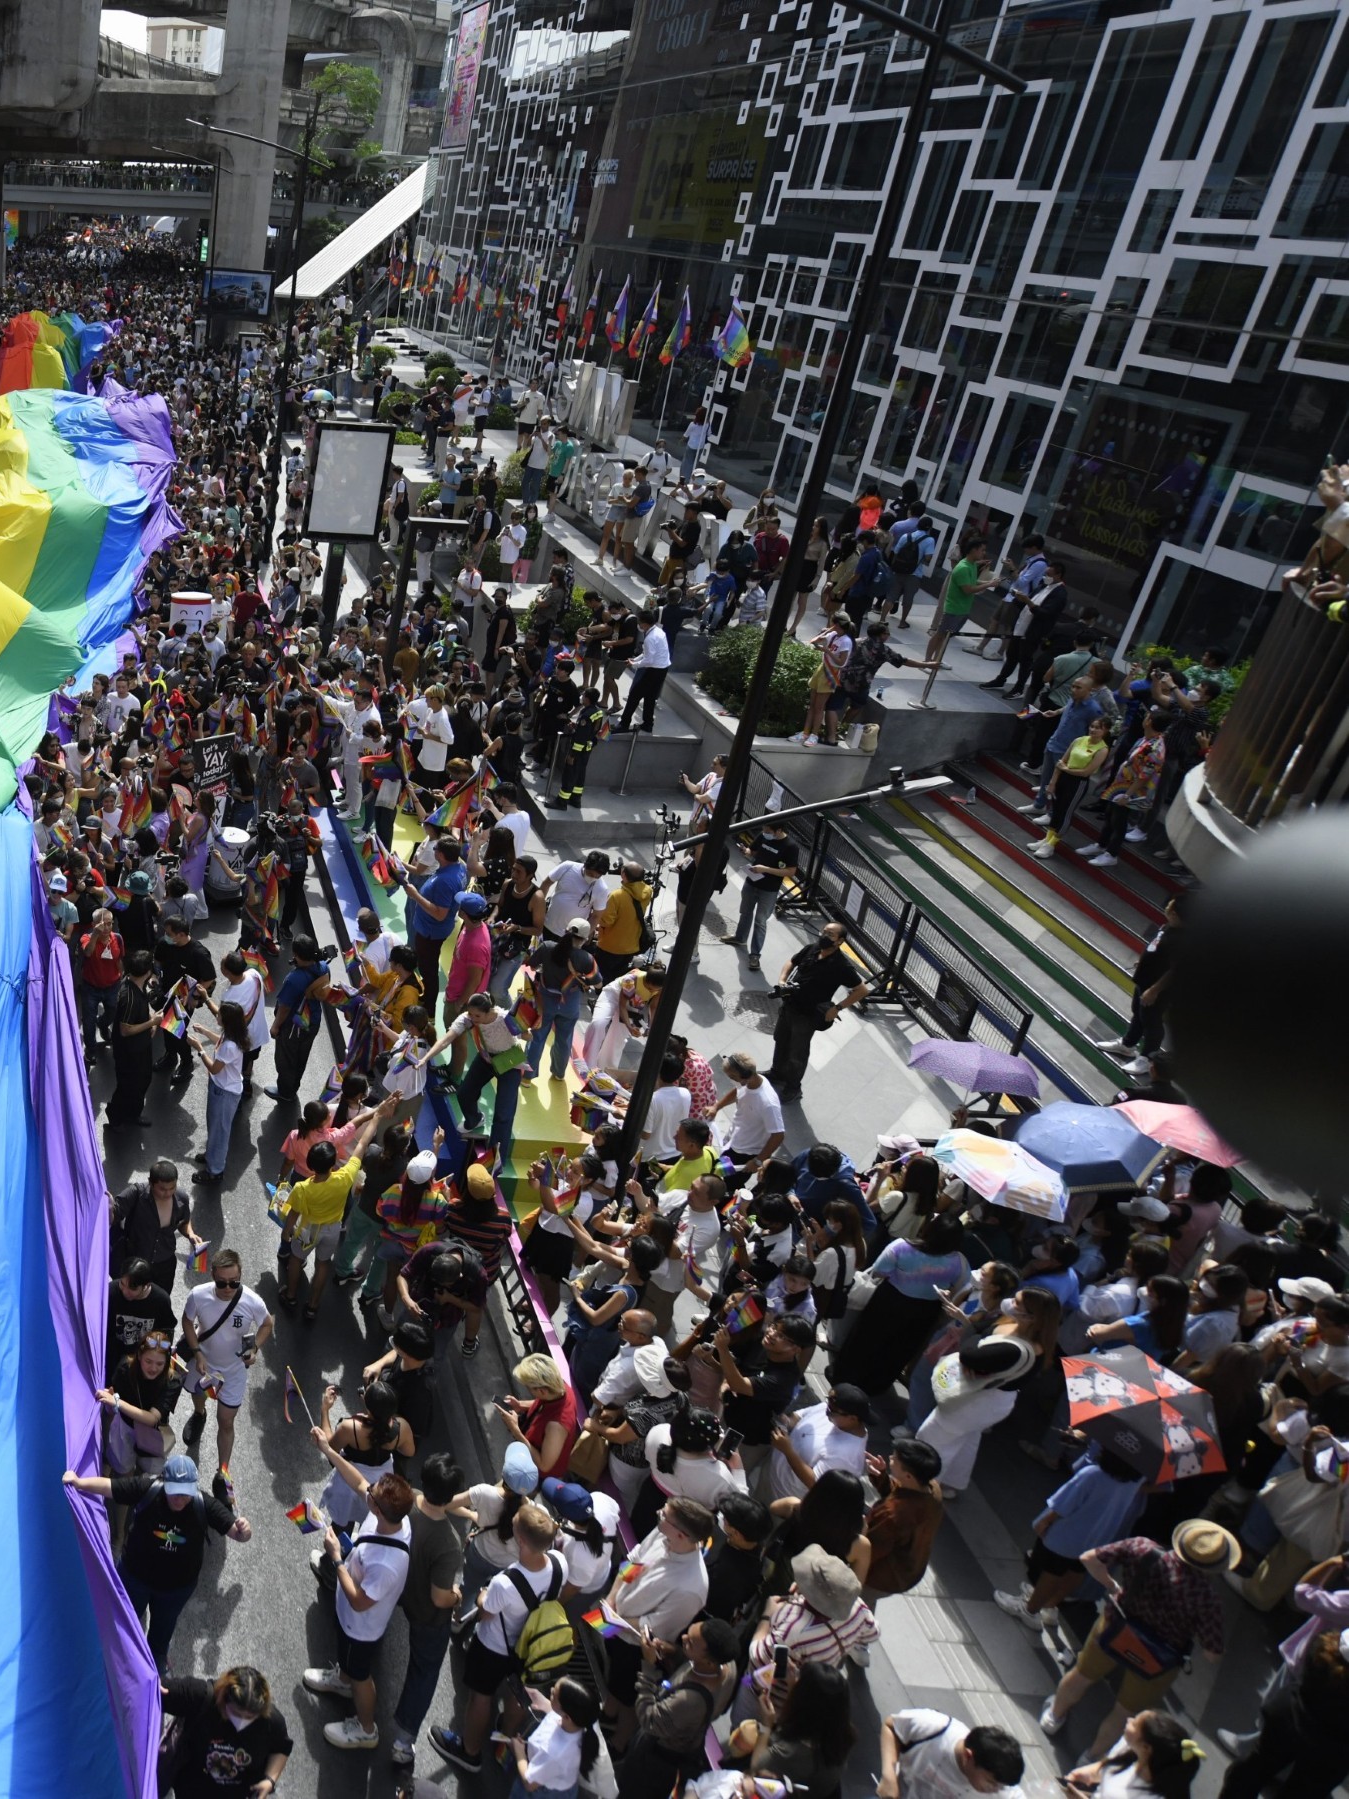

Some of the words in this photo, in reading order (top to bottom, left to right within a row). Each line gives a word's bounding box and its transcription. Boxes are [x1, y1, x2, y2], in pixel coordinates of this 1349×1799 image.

[707, 159, 755, 181] SURPRISE
[1082, 473, 1161, 527] Madame
[203, 743, 218, 754] Let's
[204, 751, 227, 768] YAY
[203, 762, 227, 777] today!
